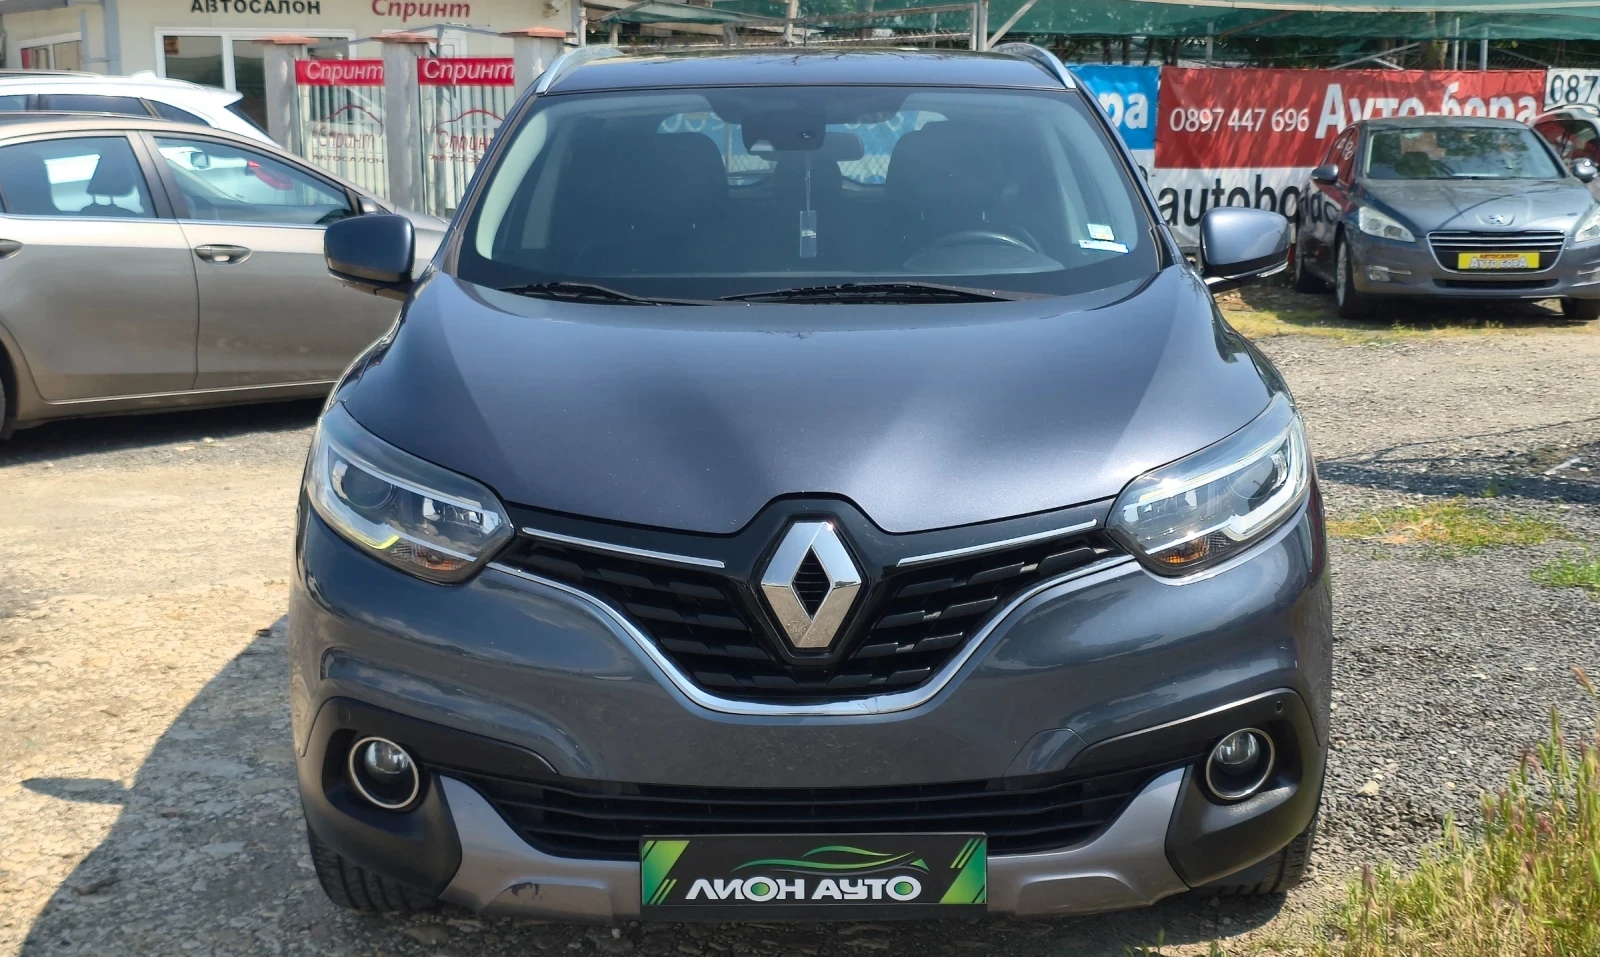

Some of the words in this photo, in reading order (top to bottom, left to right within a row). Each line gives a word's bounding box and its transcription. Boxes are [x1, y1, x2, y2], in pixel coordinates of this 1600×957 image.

[191, 0, 321, 14] АВТОСАЛОН
[372, 0, 470, 22] Спринт
[307, 62, 384, 85] Спринт
[424, 60, 515, 84] Спринт
[1550, 74, 1600, 104] 087
[1169, 107, 1226, 132] 0897
[1228, 107, 1265, 132] 447
[1271, 107, 1310, 132] 696
[437, 130, 494, 152] Сприн
[685, 876, 805, 901] ЛИОН
[811, 876, 921, 900] АУТО
